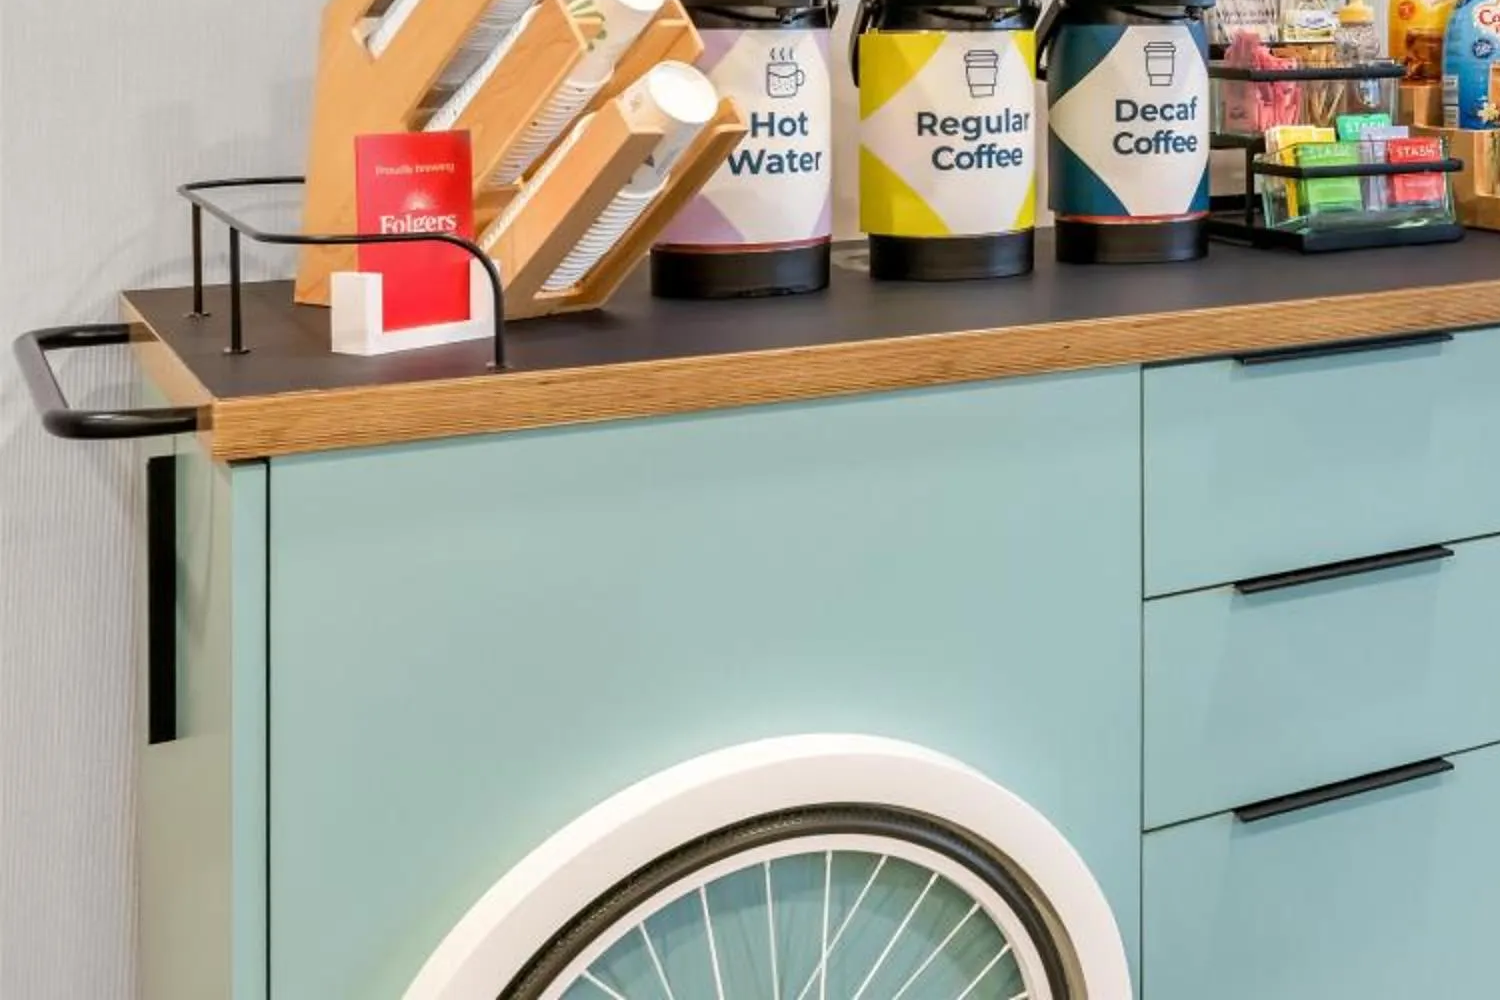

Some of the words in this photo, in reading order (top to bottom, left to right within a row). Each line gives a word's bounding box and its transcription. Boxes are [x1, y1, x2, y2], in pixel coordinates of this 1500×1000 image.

[1115, 96, 1198, 123] Decaf
[751, 111, 809, 138] Hot
[916, 108, 1031, 142] Regular
[1113, 130, 1198, 156] Coffee
[728, 149, 823, 176] Water
[931, 143, 1024, 171] Coffee
[380, 214, 457, 235] Folgers
